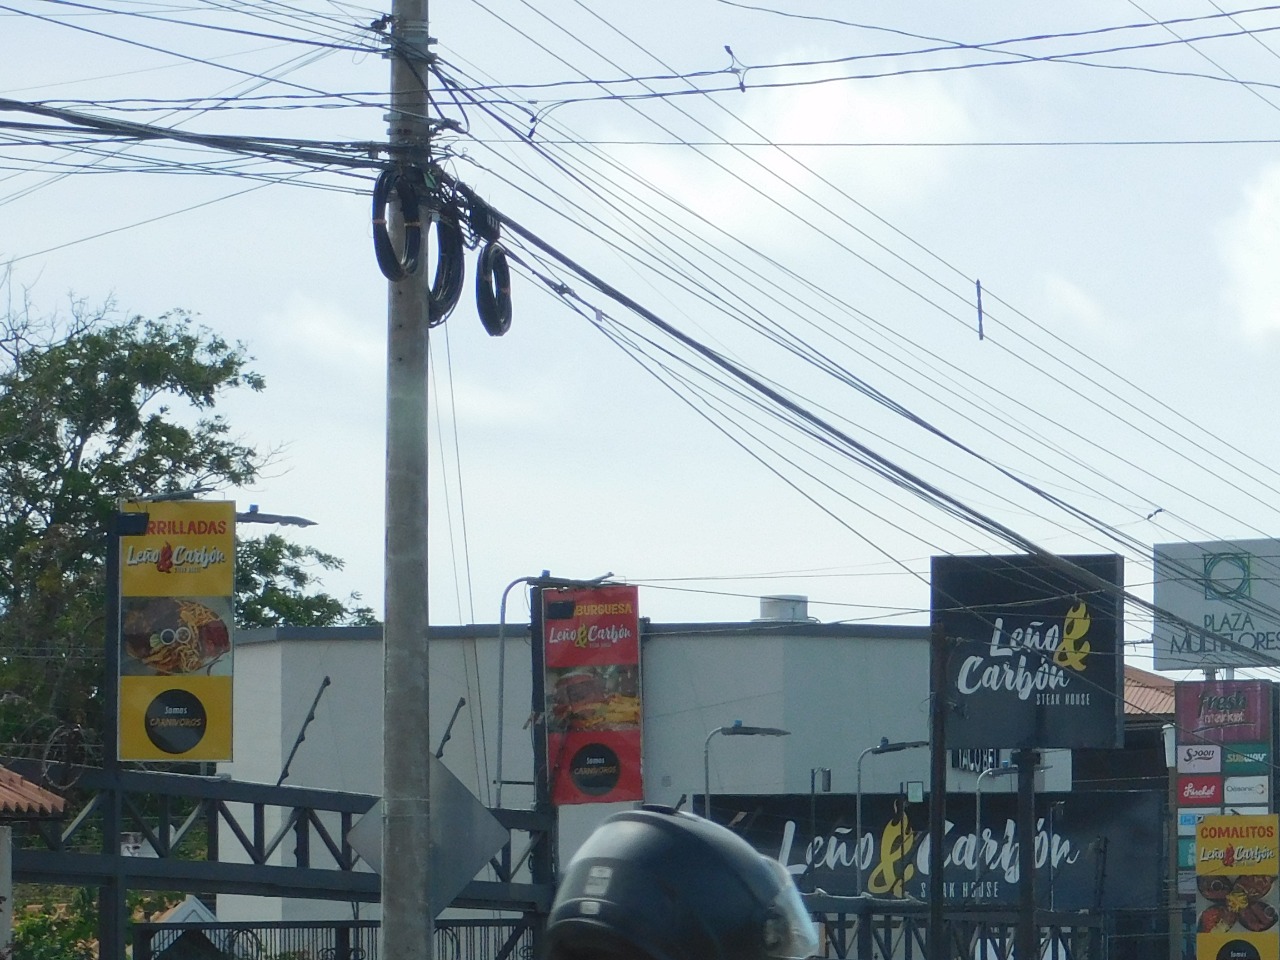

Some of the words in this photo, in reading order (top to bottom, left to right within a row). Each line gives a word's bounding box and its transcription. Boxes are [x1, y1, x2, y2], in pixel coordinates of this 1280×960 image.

[147, 520, 227, 535] RRILLADAS
[127, 545, 161, 566] Leño
[574, 603, 632, 616] BURGUESA
[1203, 613, 1255, 632] PLAZA
[549, 627, 576, 644] Leño
[588, 624, 632, 643] Carbón
[990, 617, 1059, 657] Leño
[957, 654, 1070, 700] Carbón
[1036, 693, 1060, 705] STEAK
[1065, 693, 1090, 705] HOUSE
[1200, 825, 1274, 839] COMALITOS
[778, 820, 874, 875] Leño
[921, 882, 955, 898] SAK
